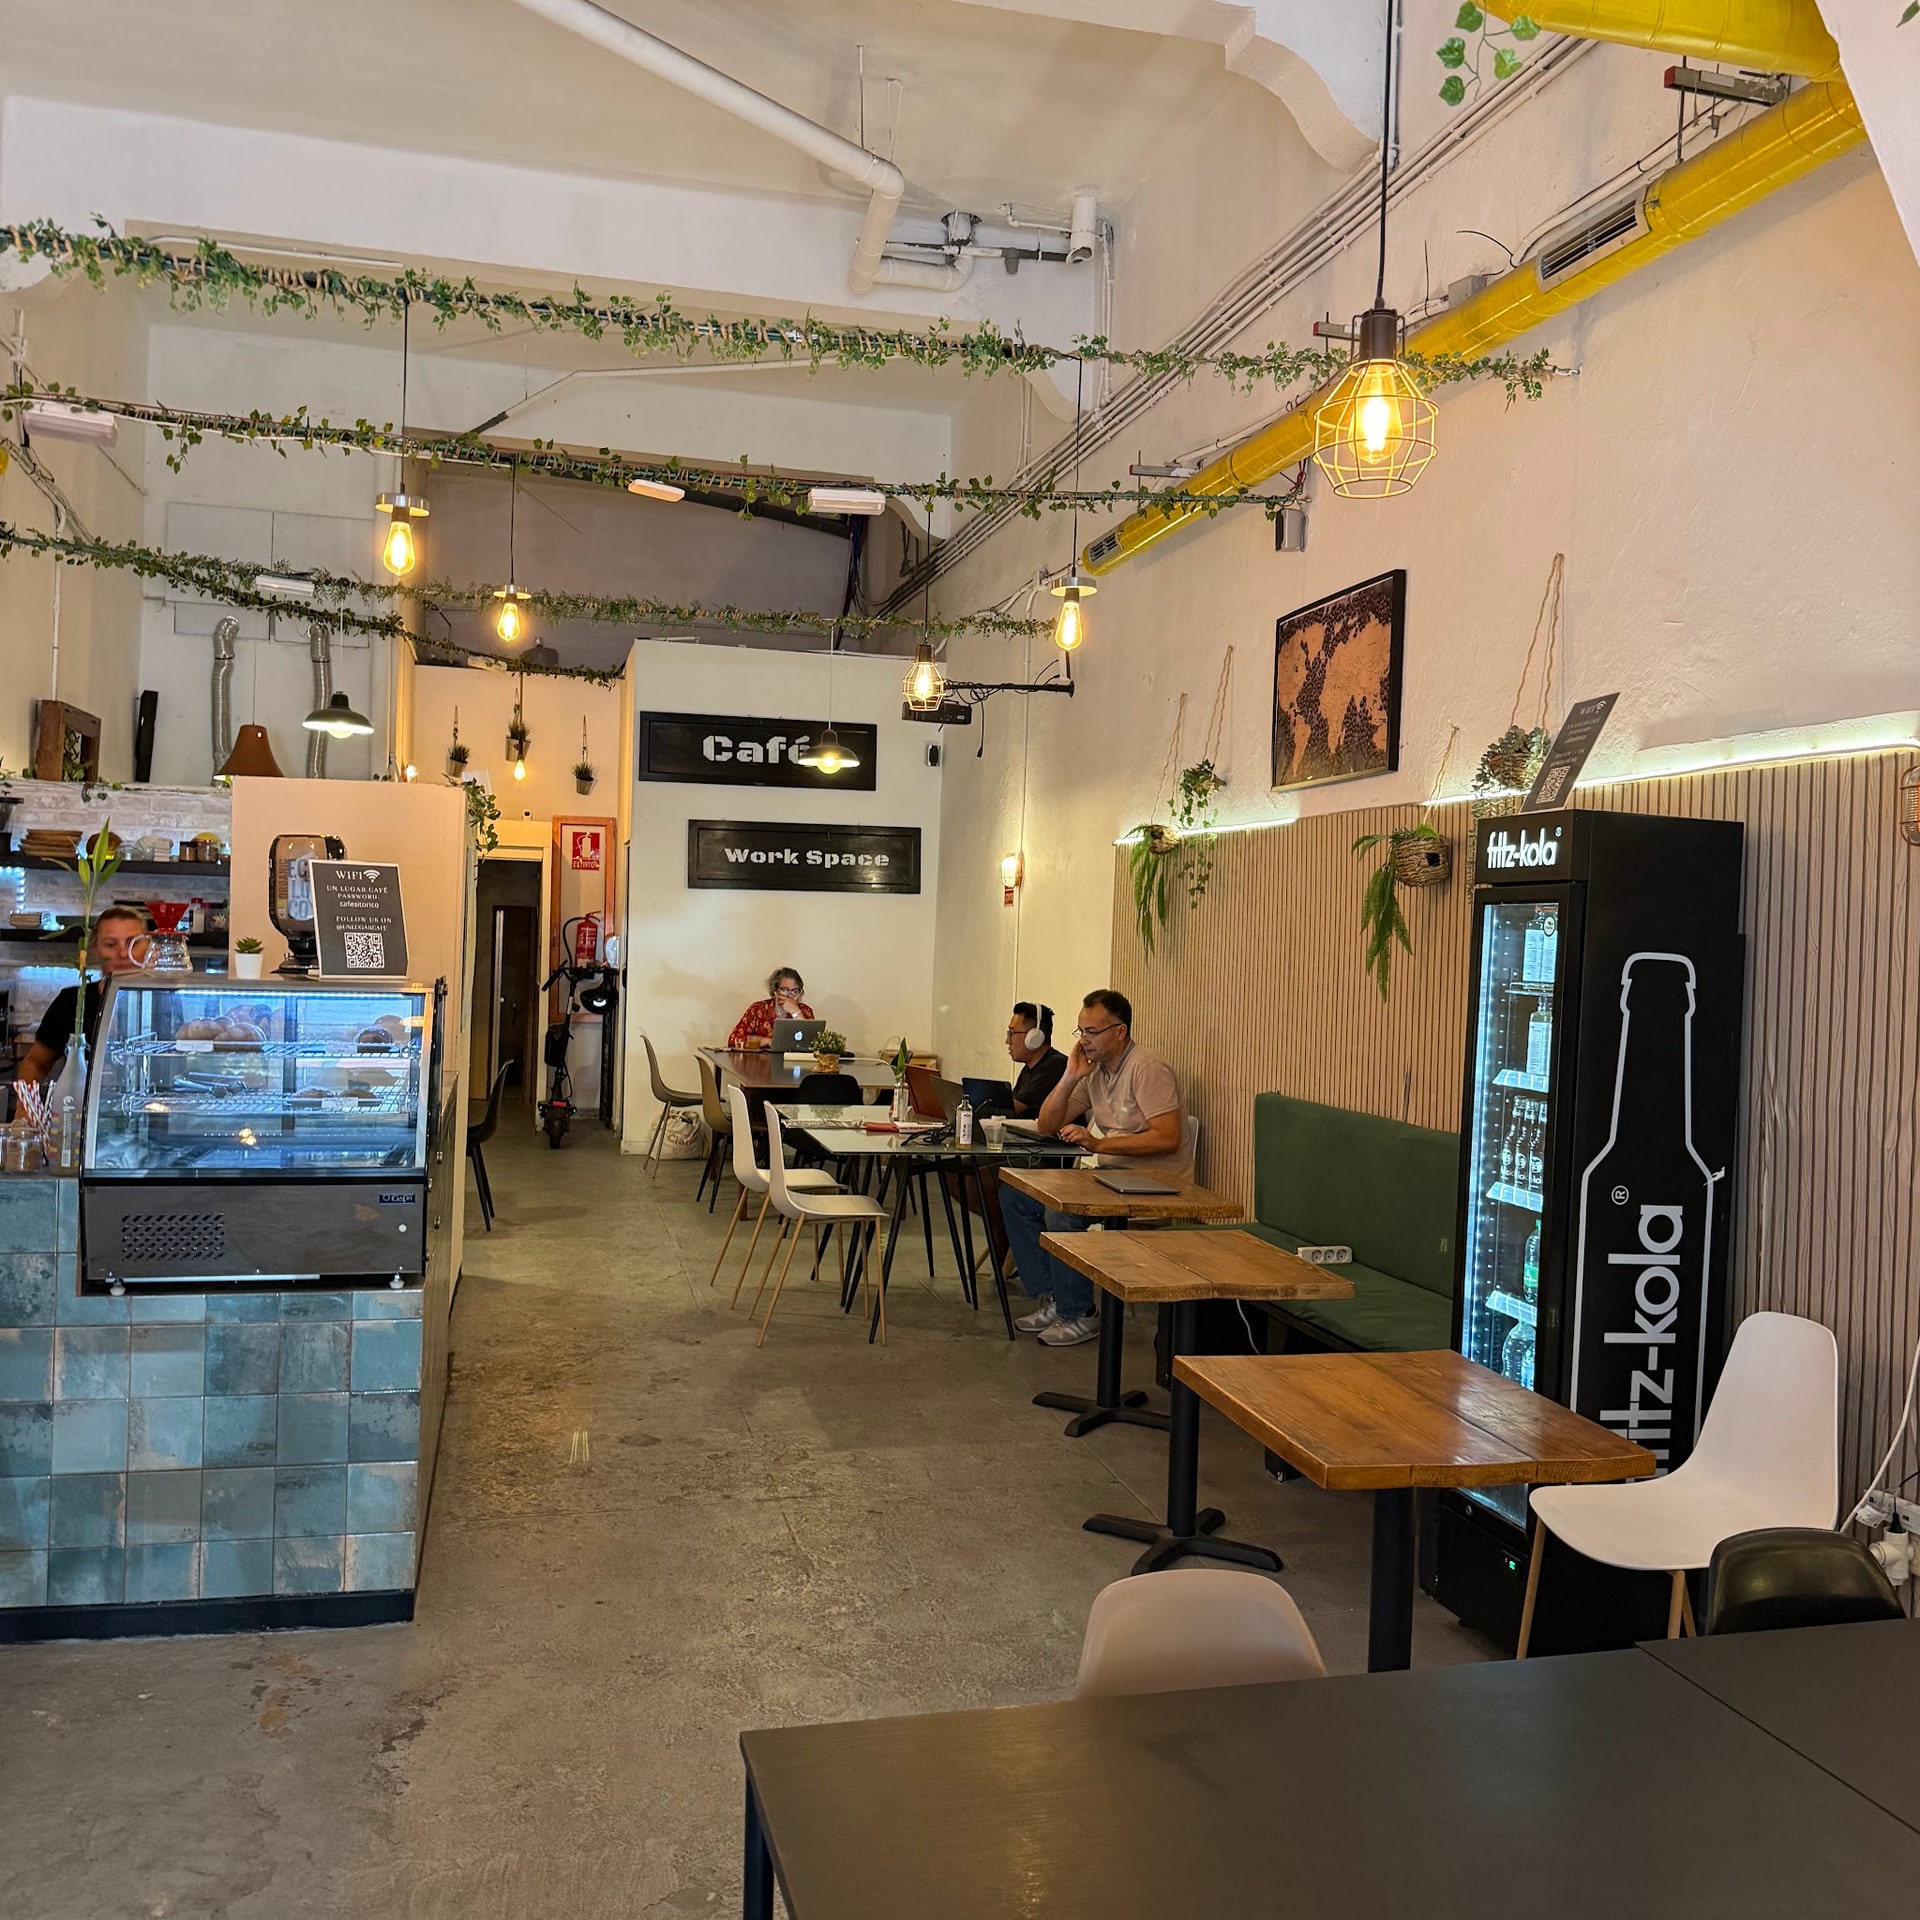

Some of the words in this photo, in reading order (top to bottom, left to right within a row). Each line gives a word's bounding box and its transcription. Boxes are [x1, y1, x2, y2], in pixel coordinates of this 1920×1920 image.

[724, 848, 799, 865] Work
[806, 850, 889, 868] Space
[335, 870, 363, 880] WIFI
[326, 884, 338, 892] UN
[1600, 1204, 1683, 1483] itz-kola
